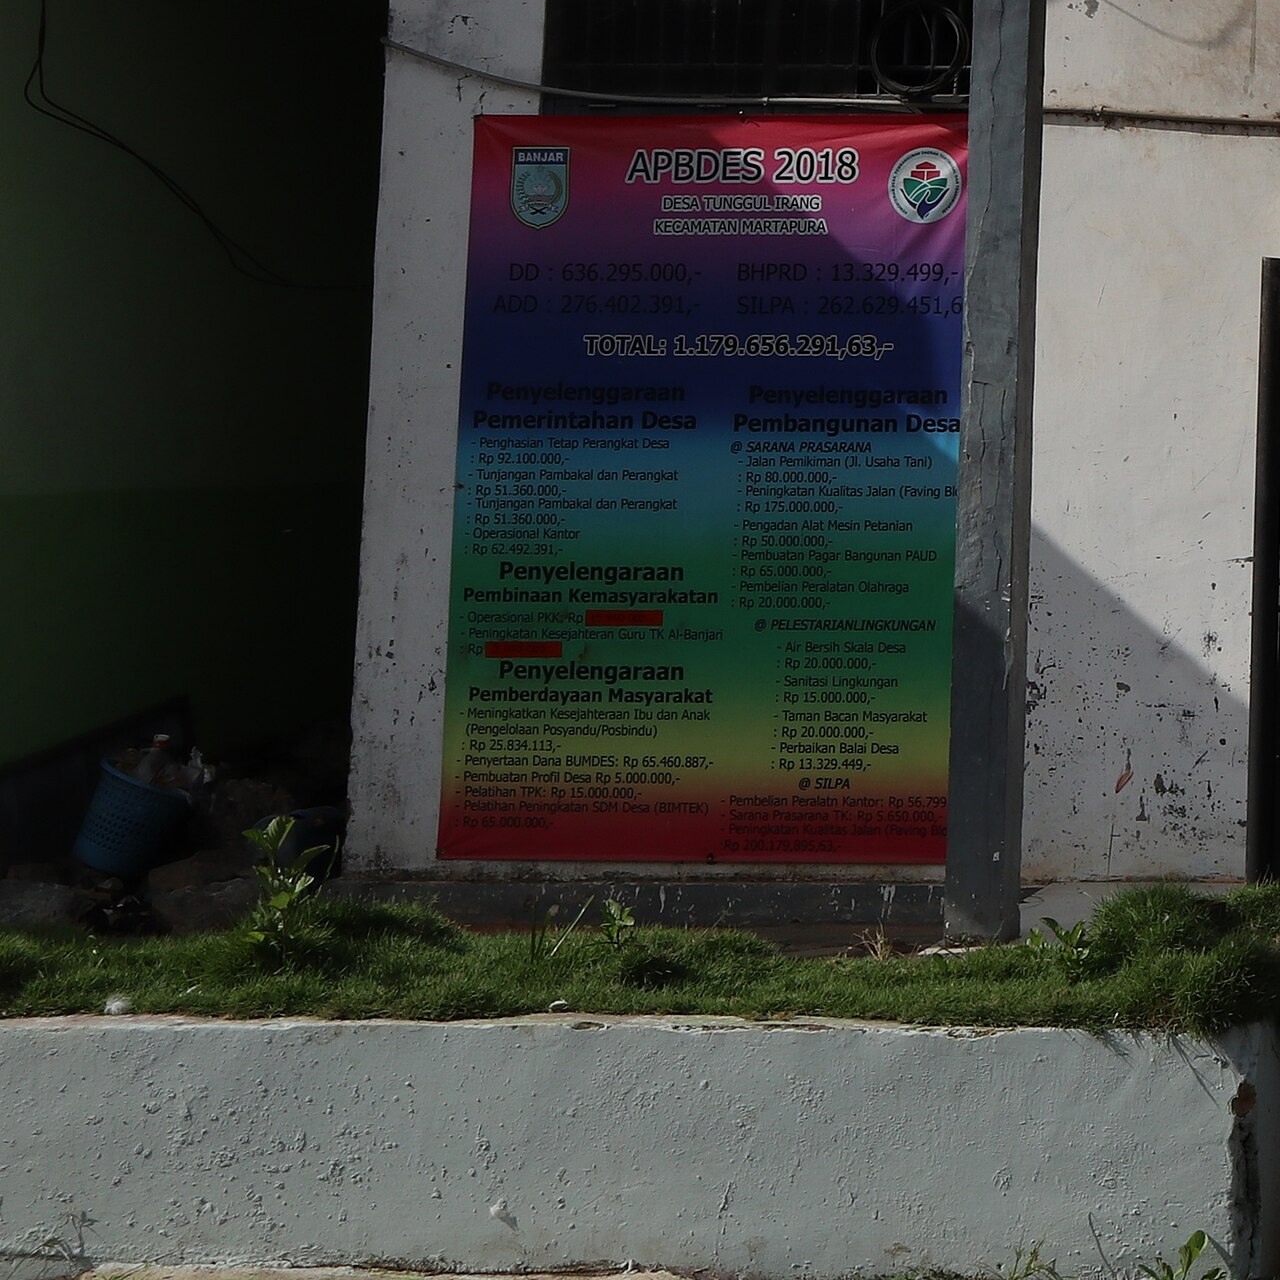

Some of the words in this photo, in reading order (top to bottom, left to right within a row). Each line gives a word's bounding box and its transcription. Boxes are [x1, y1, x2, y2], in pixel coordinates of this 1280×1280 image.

[517, 151, 564, 163] BANJAR
[626, 149, 764, 183] APBDES
[774, 149, 859, 183] 2018
[662, 195, 699, 211] DESA
[702, 195, 771, 211] TUNGGUL
[775, 195, 822, 211] IRANG
[654, 219, 738, 235] KECAMATAN
[741, 219, 828, 235] MARTAPURA
[509, 263, 540, 282] DD
[561, 263, 702, 286] 636.295.000,-
[737, 263, 808, 283] BHPRD
[831, 263, 958, 286] 13.329.499,-
[493, 295, 538, 315] ADD
[560, 295, 701, 318] 276.402.391,-
[736, 296, 796, 315] SILPA
[584, 335, 668, 356] TOTAL:
[673, 335, 895, 357] 1.179.656.291,63,-
[487, 382, 685, 405] Penyelenggaraan
[750, 385, 948, 408] Penyelenggaraan
[473, 410, 634, 429] Pemerintahan
[641, 411, 697, 430] Desa
[733, 414, 898, 436] Pembangunan
[905, 414, 961, 433] Desa
[479, 437, 543, 450] Penghasian
[547, 437, 579, 450] Tetap
[583, 438, 638, 450] Perangkat
[642, 439, 669, 449] Desa
[746, 441, 795, 453] SARANA
[799, 441, 872, 453] PRASARANA
[478, 454, 494, 466] Rp
[497, 453, 570, 466] 92.100.000,-
[499, 561, 685, 585] Penyelengaraan
[463, 587, 562, 603] Pembinaan
[568, 588, 719, 608] Kemasyarakatan
[770, 619, 937, 632] PELESTARIANLINGKUNGAN
[499, 660, 685, 684] Penyelengaraan
[783, 677, 828, 688] Sanitasi
[832, 677, 898, 689] Lingkungan
[468, 687, 602, 706] Pemberdayaan
[608, 688, 714, 706] Masyarakat
[782, 710, 821, 722] Taman
[824, 711, 858, 722] Bacan
[862, 711, 928, 724] Masyarakat
[779, 743, 836, 754] Perbaikan
[839, 743, 867, 754] Balai
[870, 744, 900, 755] Desa
[814, 778, 850, 789] SILPA
